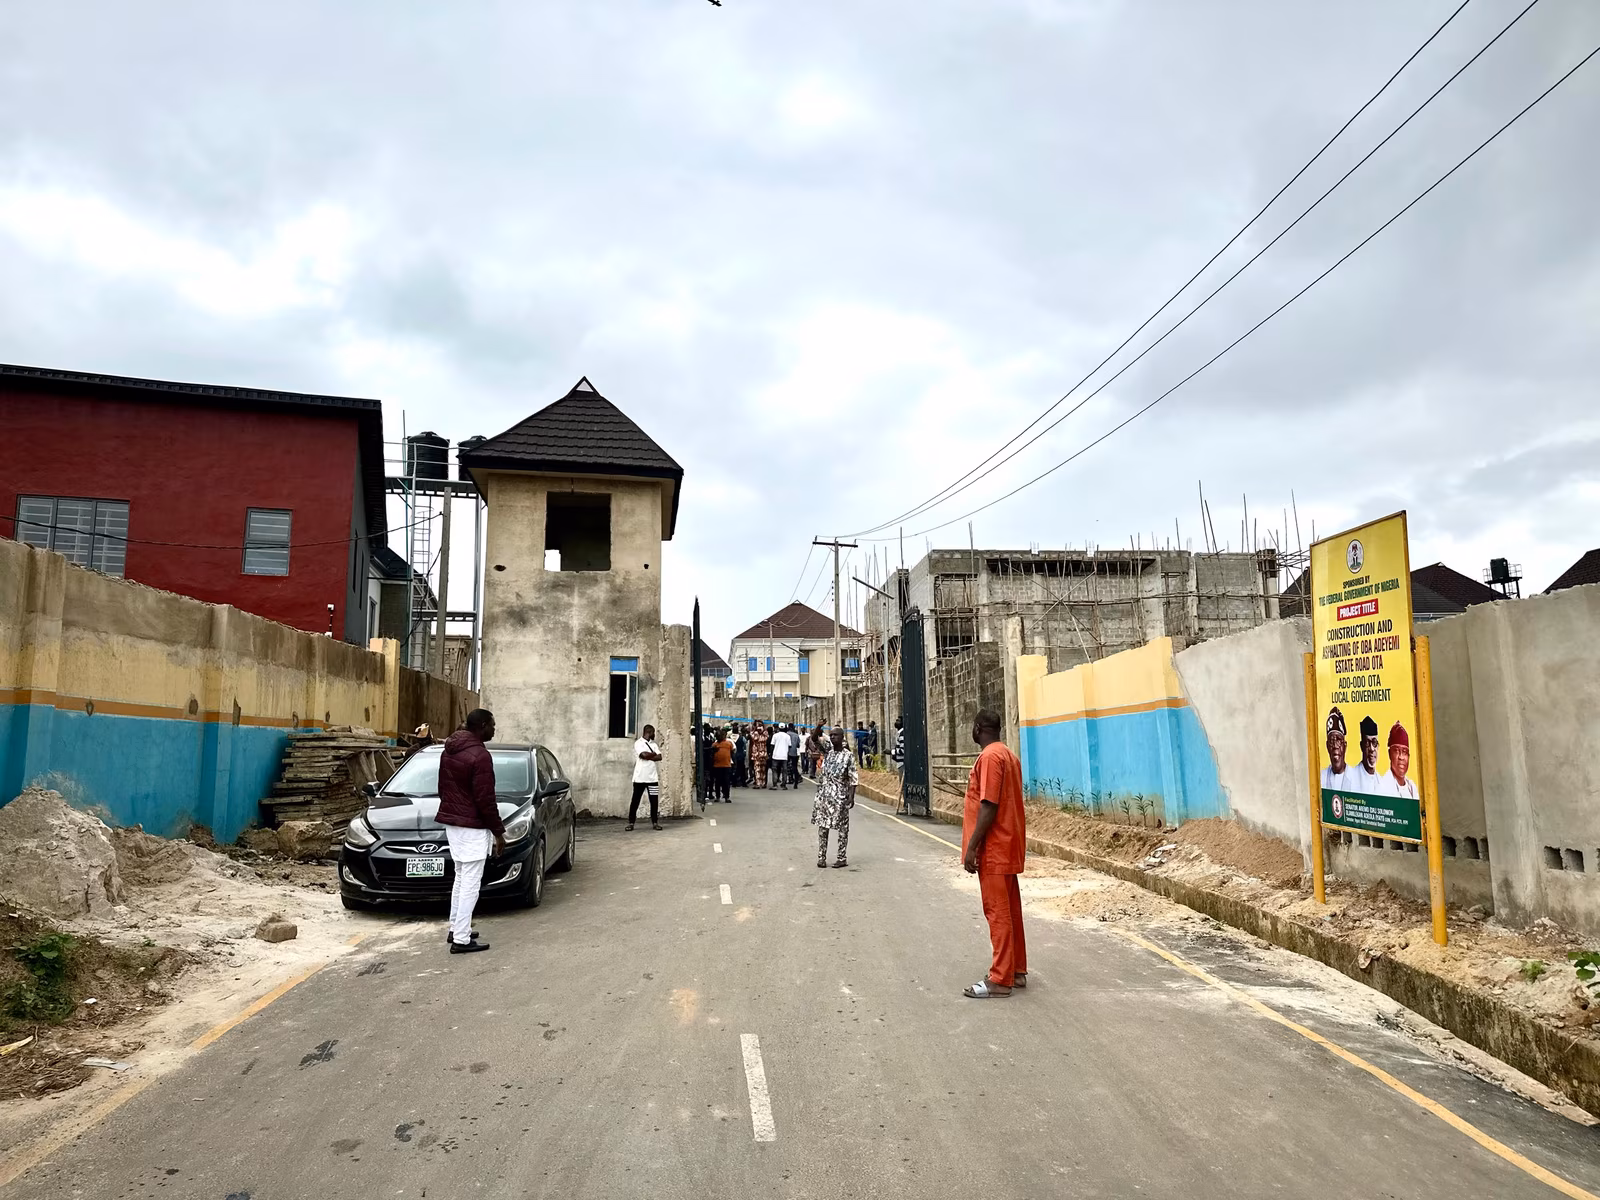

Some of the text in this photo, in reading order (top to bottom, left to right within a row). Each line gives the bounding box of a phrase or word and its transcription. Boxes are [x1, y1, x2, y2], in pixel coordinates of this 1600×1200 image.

[1342, 575, 1370, 589] SPONSORED BY
[1326, 592, 1343, 604] FEDERAL
[1344, 585, 1373, 600] GOVERNMENT
[1375, 583, 1380, 594] OF
[1381, 578, 1400, 592] NIGERIA
[1340, 602, 1375, 618] PROJECT TITLE
[1327, 619, 1392, 641] CONSTRUCTION AND
[1322, 635, 1400, 659] ASPHALTING OF OBA ADEYEMI
[1335, 655, 1383, 674] ESTATE ROAD OTA
[1339, 675, 1381, 689] ADO-ODO OTA
[1332, 689, 1391, 703] LOCAL GOVERMENT
